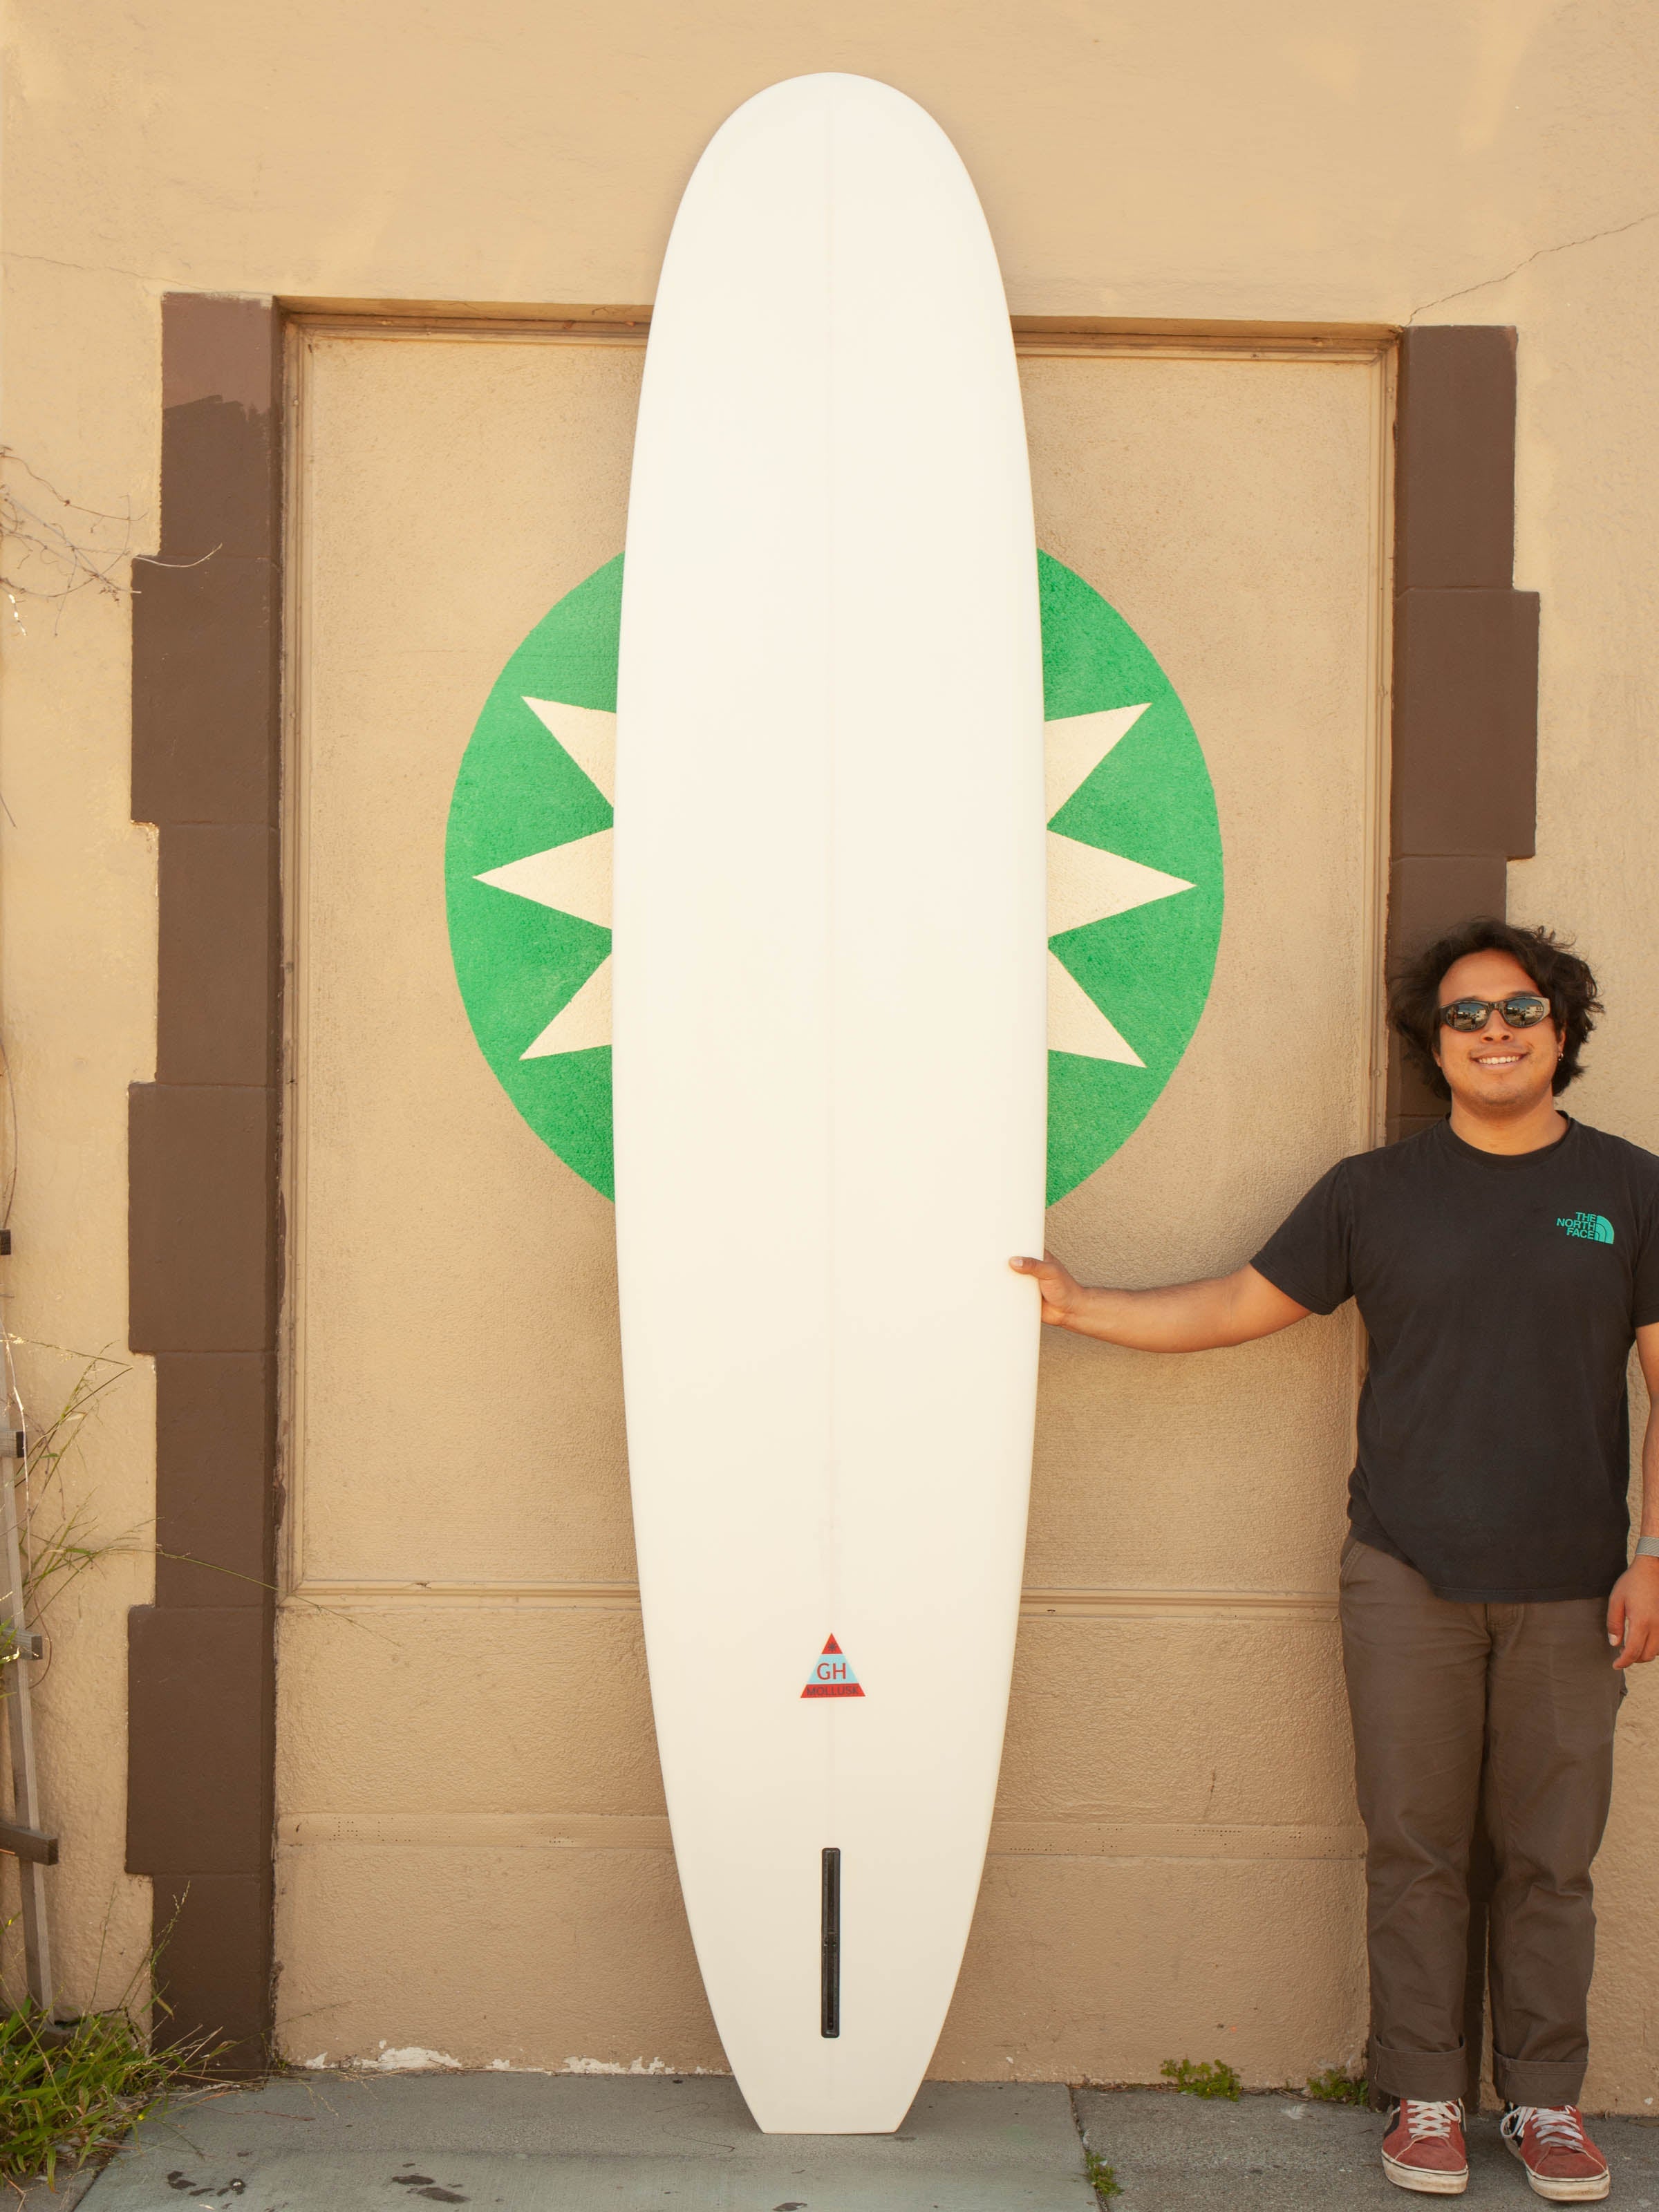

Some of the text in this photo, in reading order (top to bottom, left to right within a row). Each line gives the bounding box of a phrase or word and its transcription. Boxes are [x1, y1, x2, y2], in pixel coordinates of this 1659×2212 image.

[1575, 1212, 1597, 1223] THE
[1556, 1218, 1596, 1230] NORTH
[1566, 1227, 1595, 1239] FACE
[816, 1662, 846, 1680] GH
[807, 1685, 859, 1696] MOLLUSK
